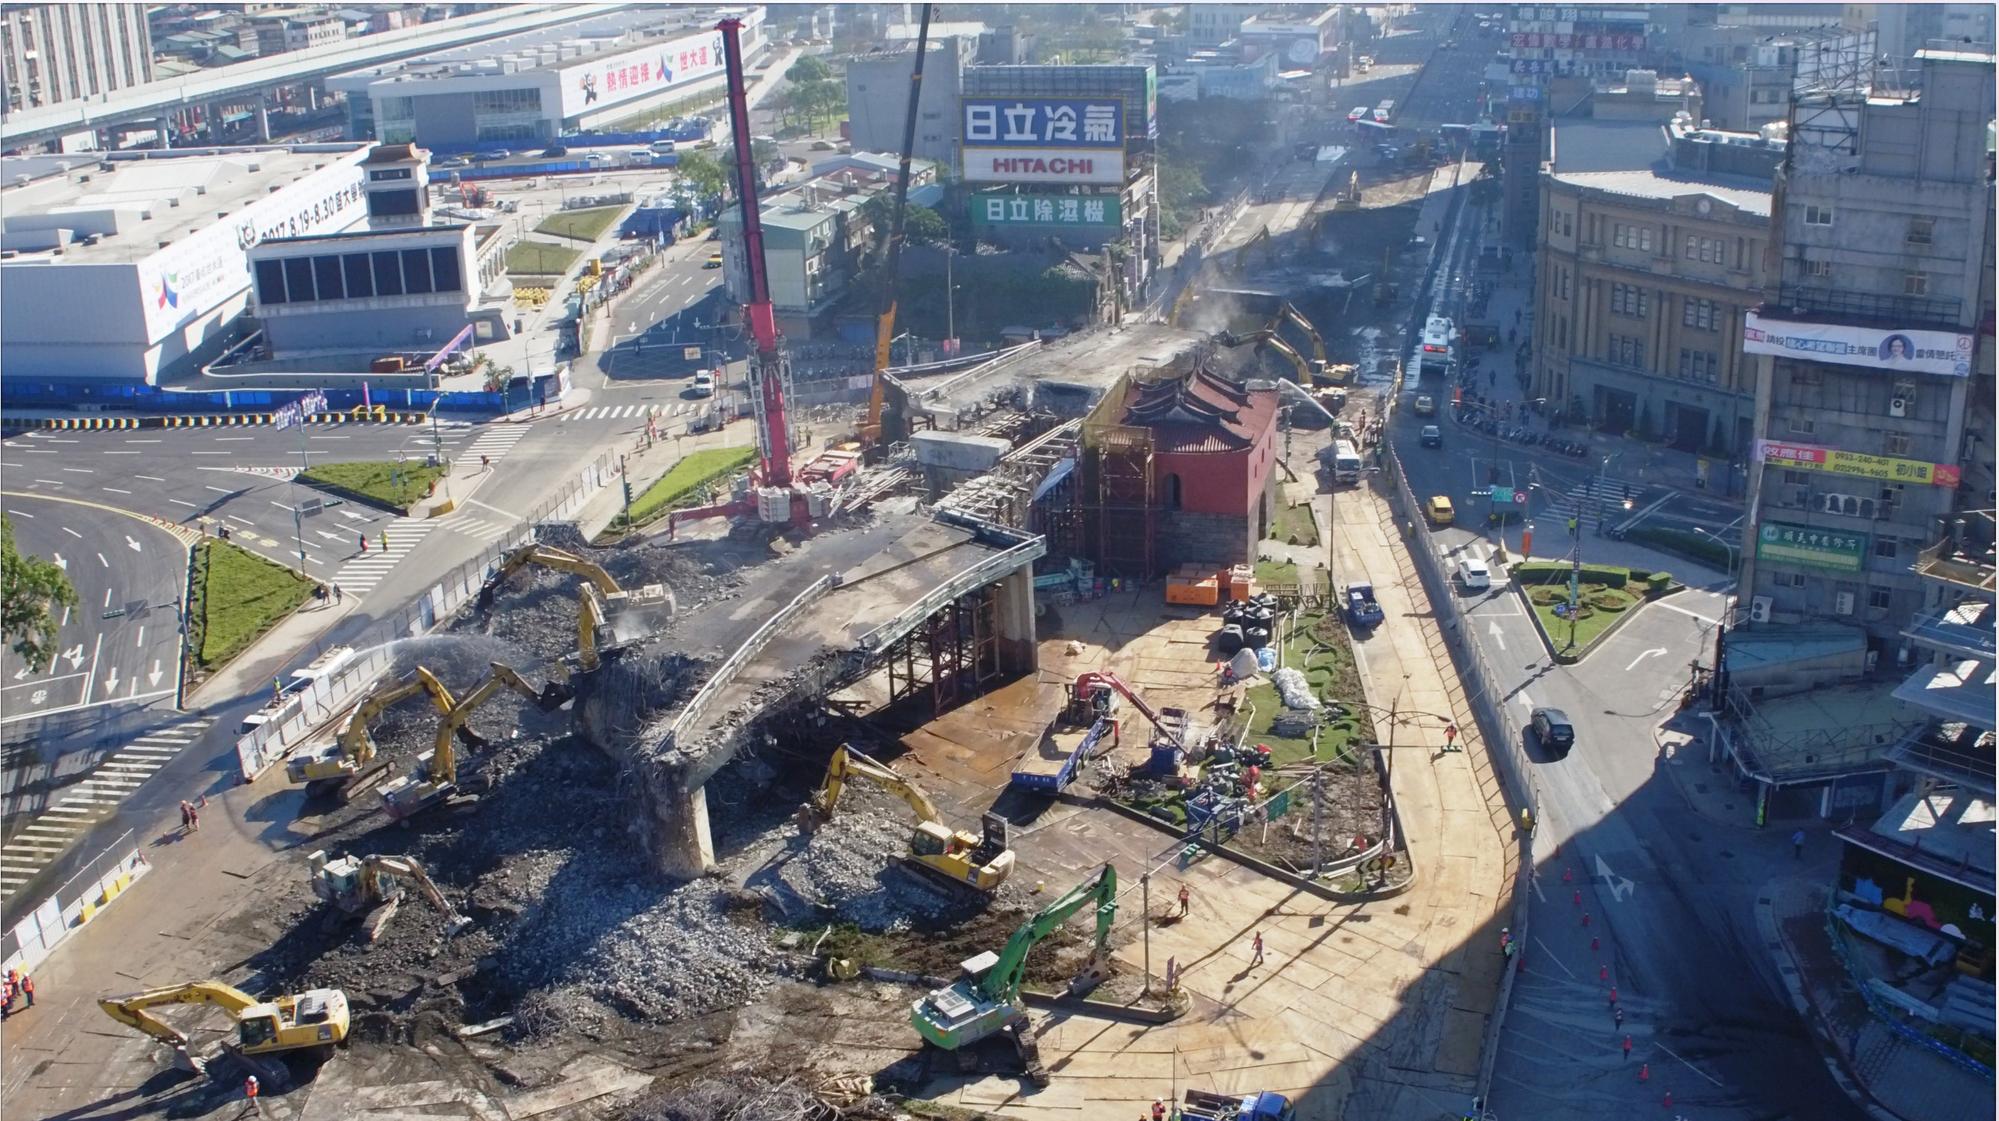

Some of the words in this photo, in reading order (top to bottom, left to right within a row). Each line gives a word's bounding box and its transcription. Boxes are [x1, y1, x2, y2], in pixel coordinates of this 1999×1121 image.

[607, 62, 650, 91] 熱情迎接
[679, 46, 709, 73] 世大運
[966, 103, 1116, 142] 日立冷氣
[993, 157, 1093, 174] HITACHI
[986, 197, 1105, 222] 日立除濕機
